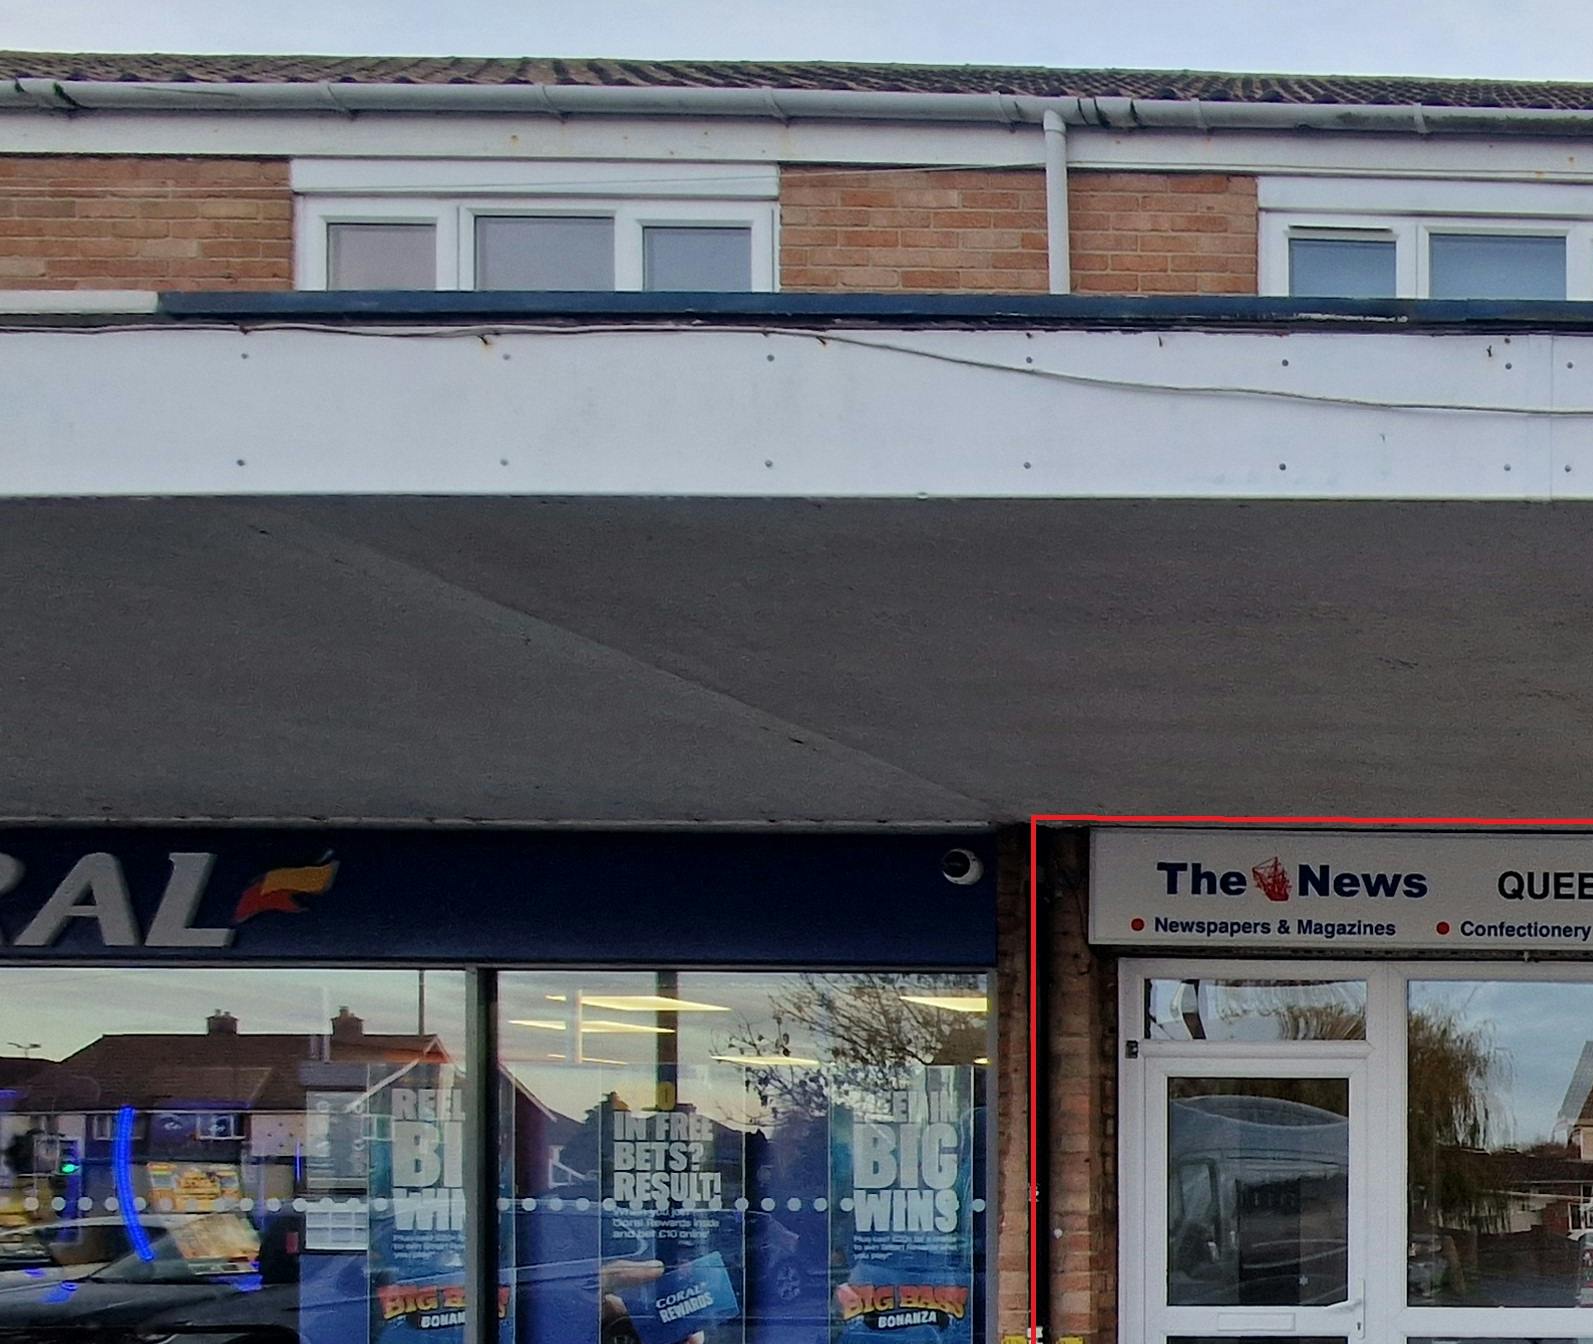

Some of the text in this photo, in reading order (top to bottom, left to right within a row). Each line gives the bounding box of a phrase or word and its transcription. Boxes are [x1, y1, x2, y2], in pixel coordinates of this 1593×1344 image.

[1157, 862, 1428, 898] The News
[1154, 917, 1396, 938] Newspapers & Magazines
[1460, 921, 1591, 941] Confectionery
[614, 1112, 713, 1141] IN FREE
[392, 1121, 463, 1187] BI
[614, 1142, 704, 1171] BETS?
[854, 1123, 958, 1190] BIG
[614, 1172, 721, 1202] RESULT!
[645, 1219, 692, 1228] Rewards
[854, 1190, 959, 1233] WINS
[658, 1230, 678, 1239] £10
[377, 1285, 438, 1320] BIG
[656, 1284, 703, 1308] CORAL
[659, 1292, 714, 1324] REWARDS
[837, 1284, 894, 1320] BIG
[878, 1311, 937, 1329] BONANZA
